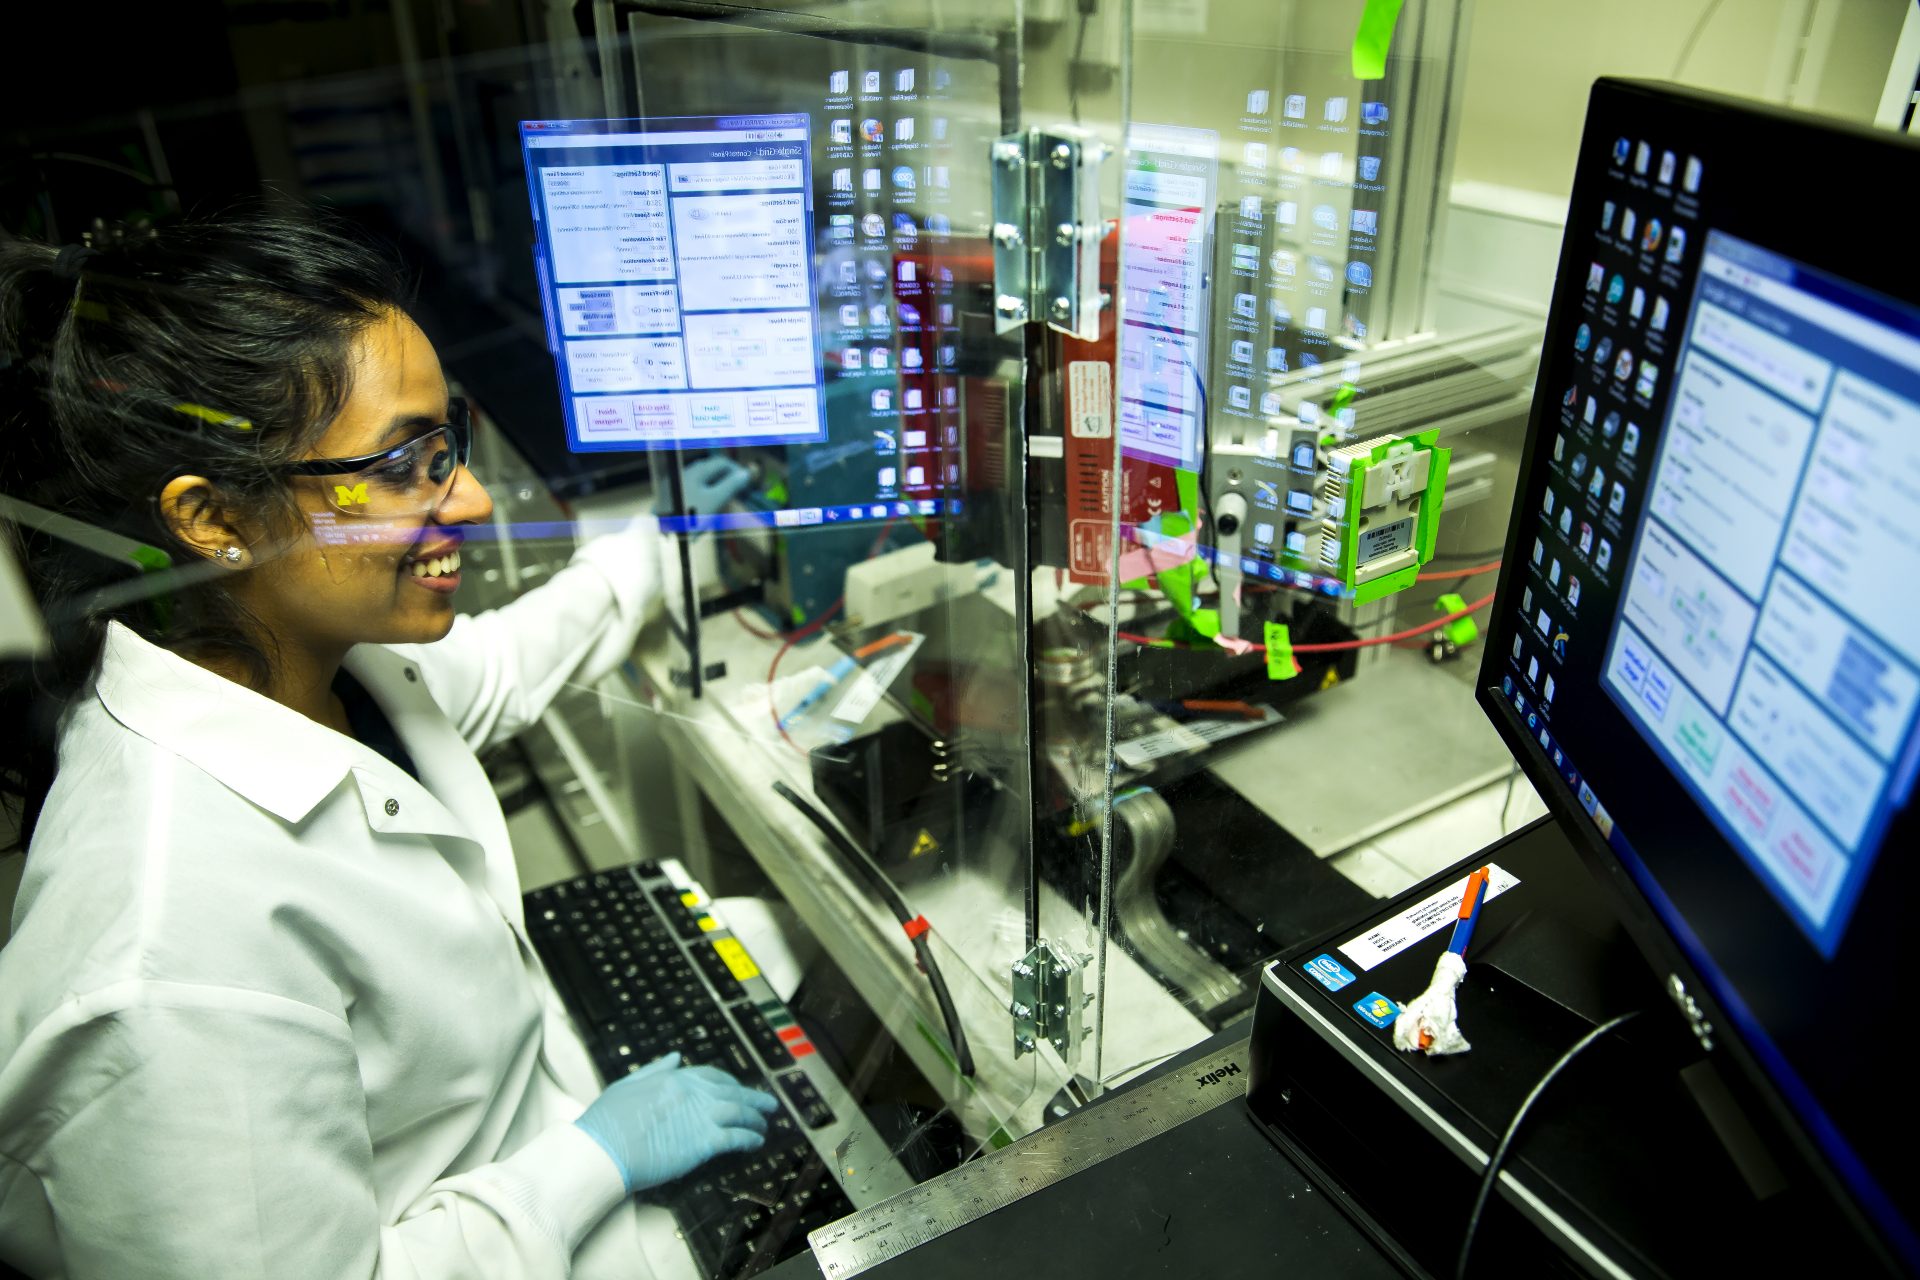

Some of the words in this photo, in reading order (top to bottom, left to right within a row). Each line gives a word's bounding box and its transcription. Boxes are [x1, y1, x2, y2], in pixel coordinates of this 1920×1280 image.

[334, 483, 371, 506] M
[1102, 469, 1110, 513] CAUTION
[1377, 939, 1393, 948] MODEL
[1382, 937, 1407, 952] WARRANTY
[1357, 1004, 1379, 1023] Windows
[1196, 1062, 1241, 1089] Helix
[1019, 1175, 1029, 1183] 14
[877, 1221, 893, 1232] MADE
[926, 1217, 936, 1226] 16
[852, 1231, 869, 1243] CHINA
[879, 1239, 888, 1248] 17
[829, 1262, 839, 1270] 18
